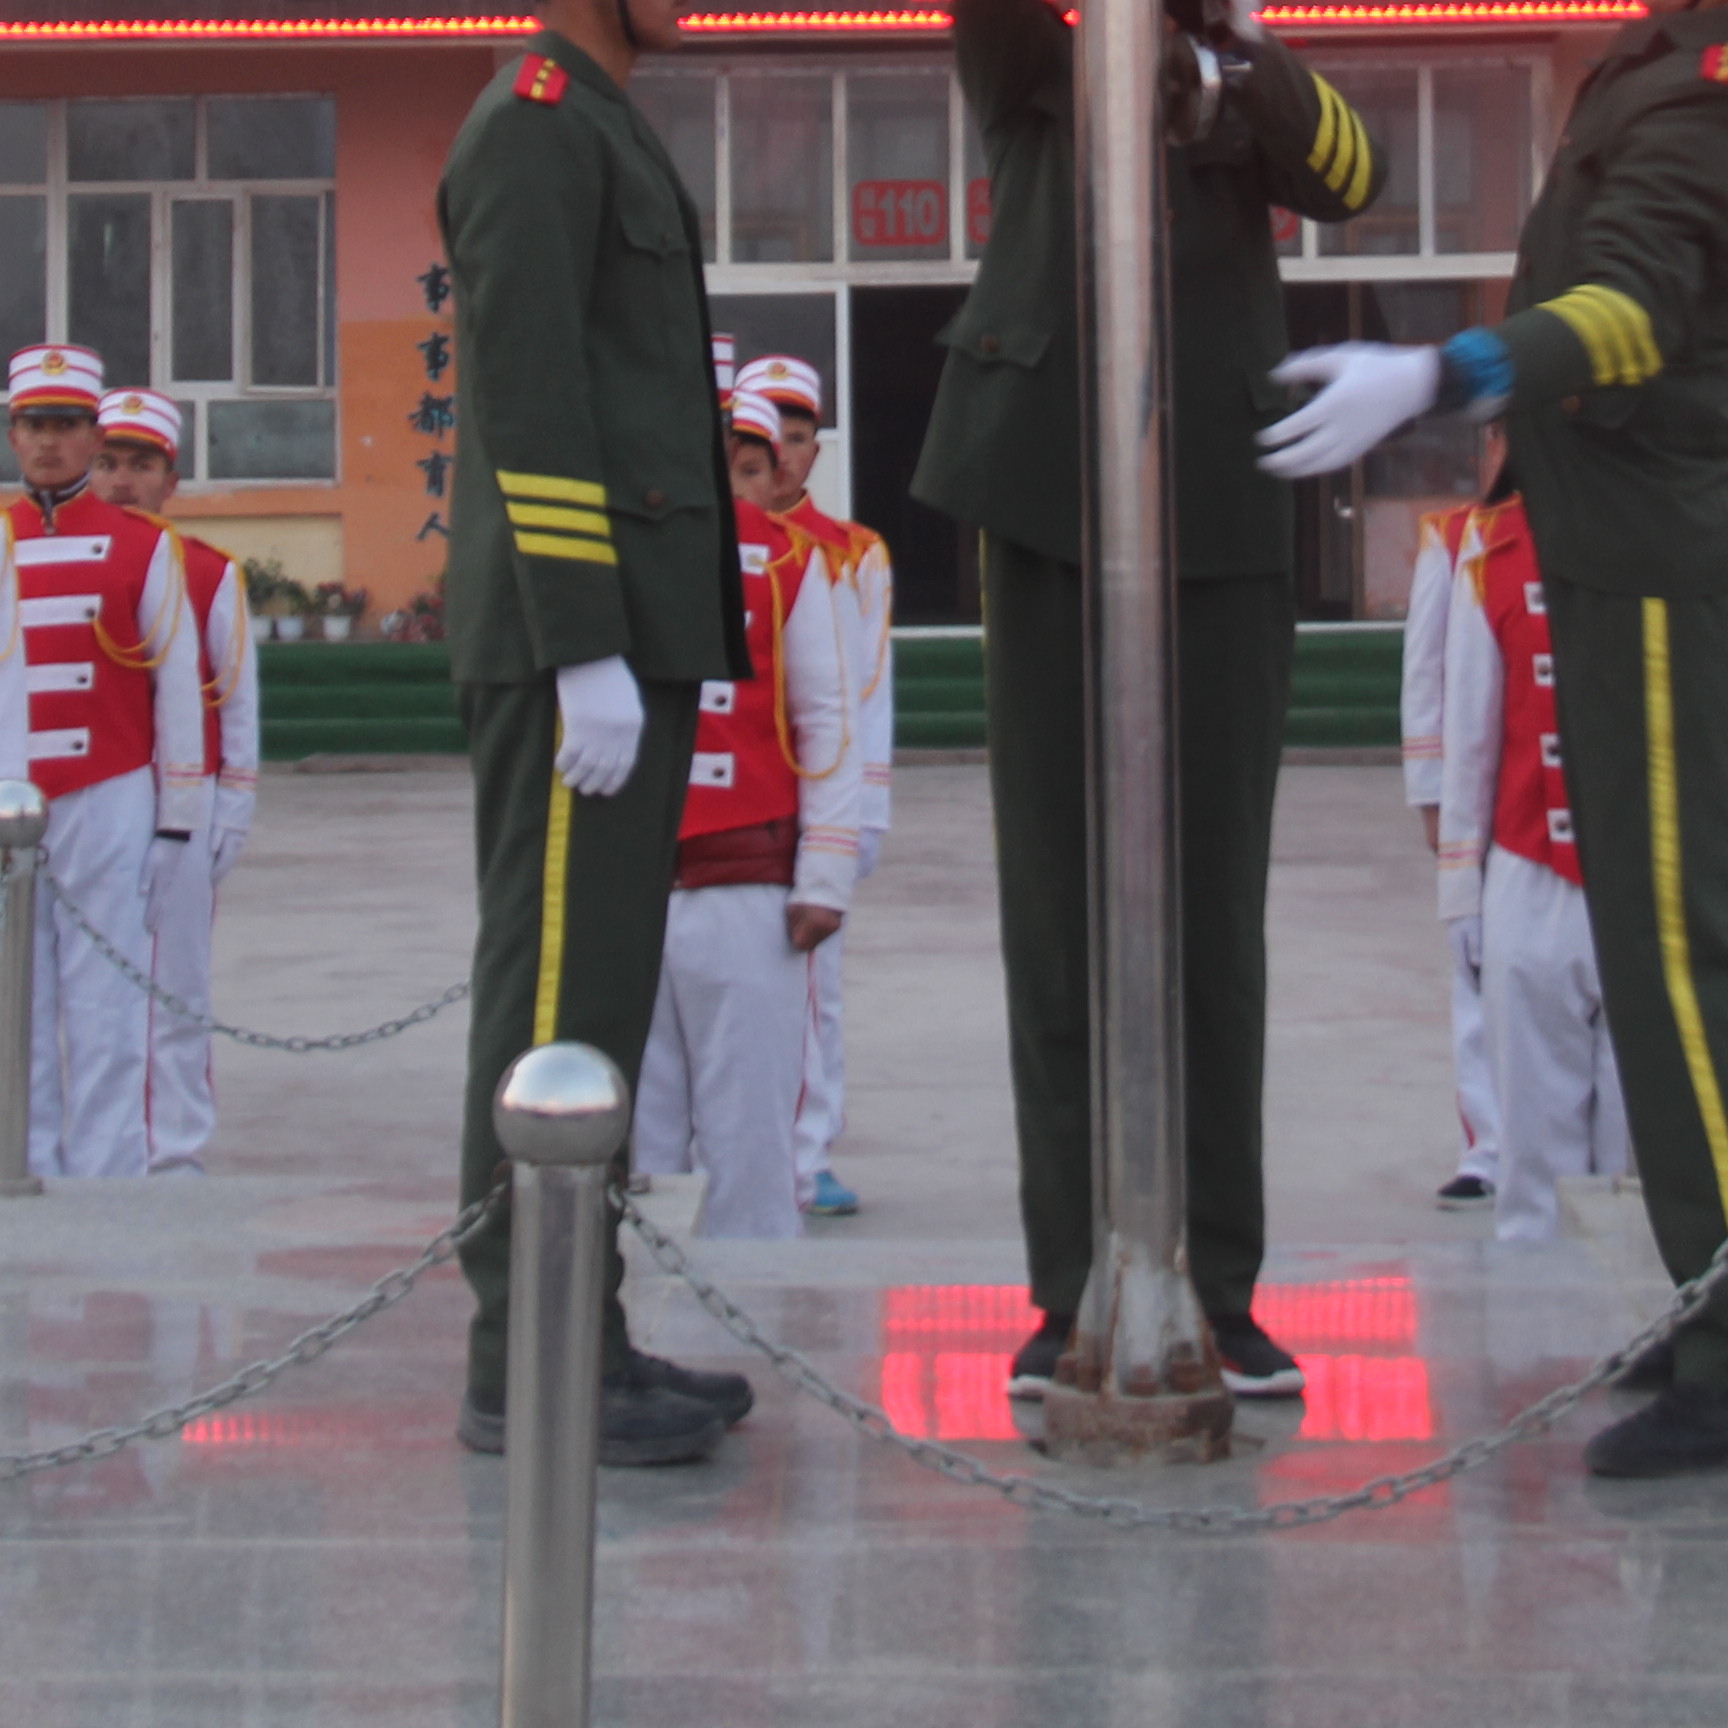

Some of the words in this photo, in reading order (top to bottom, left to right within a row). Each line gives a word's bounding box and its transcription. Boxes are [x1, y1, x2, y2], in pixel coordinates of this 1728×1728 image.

[408, 263, 455, 543] 事事都育人
